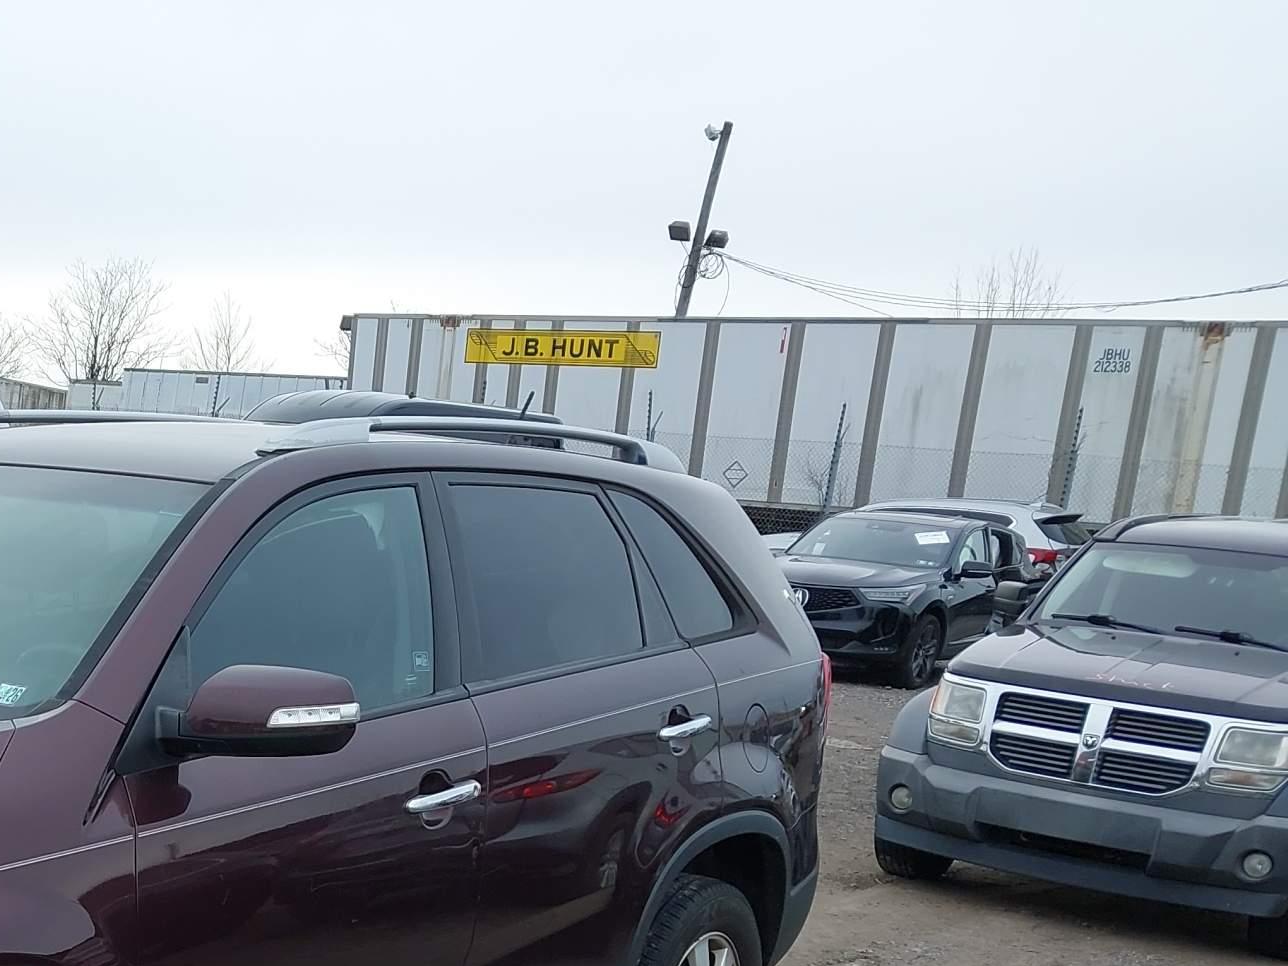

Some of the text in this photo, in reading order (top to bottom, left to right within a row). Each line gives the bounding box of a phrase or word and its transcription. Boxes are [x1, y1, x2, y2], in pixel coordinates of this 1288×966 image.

[551, 338, 620, 359] HUNT
[1099, 348, 1131, 361] JBHU
[1093, 360, 1131, 373] 212338
